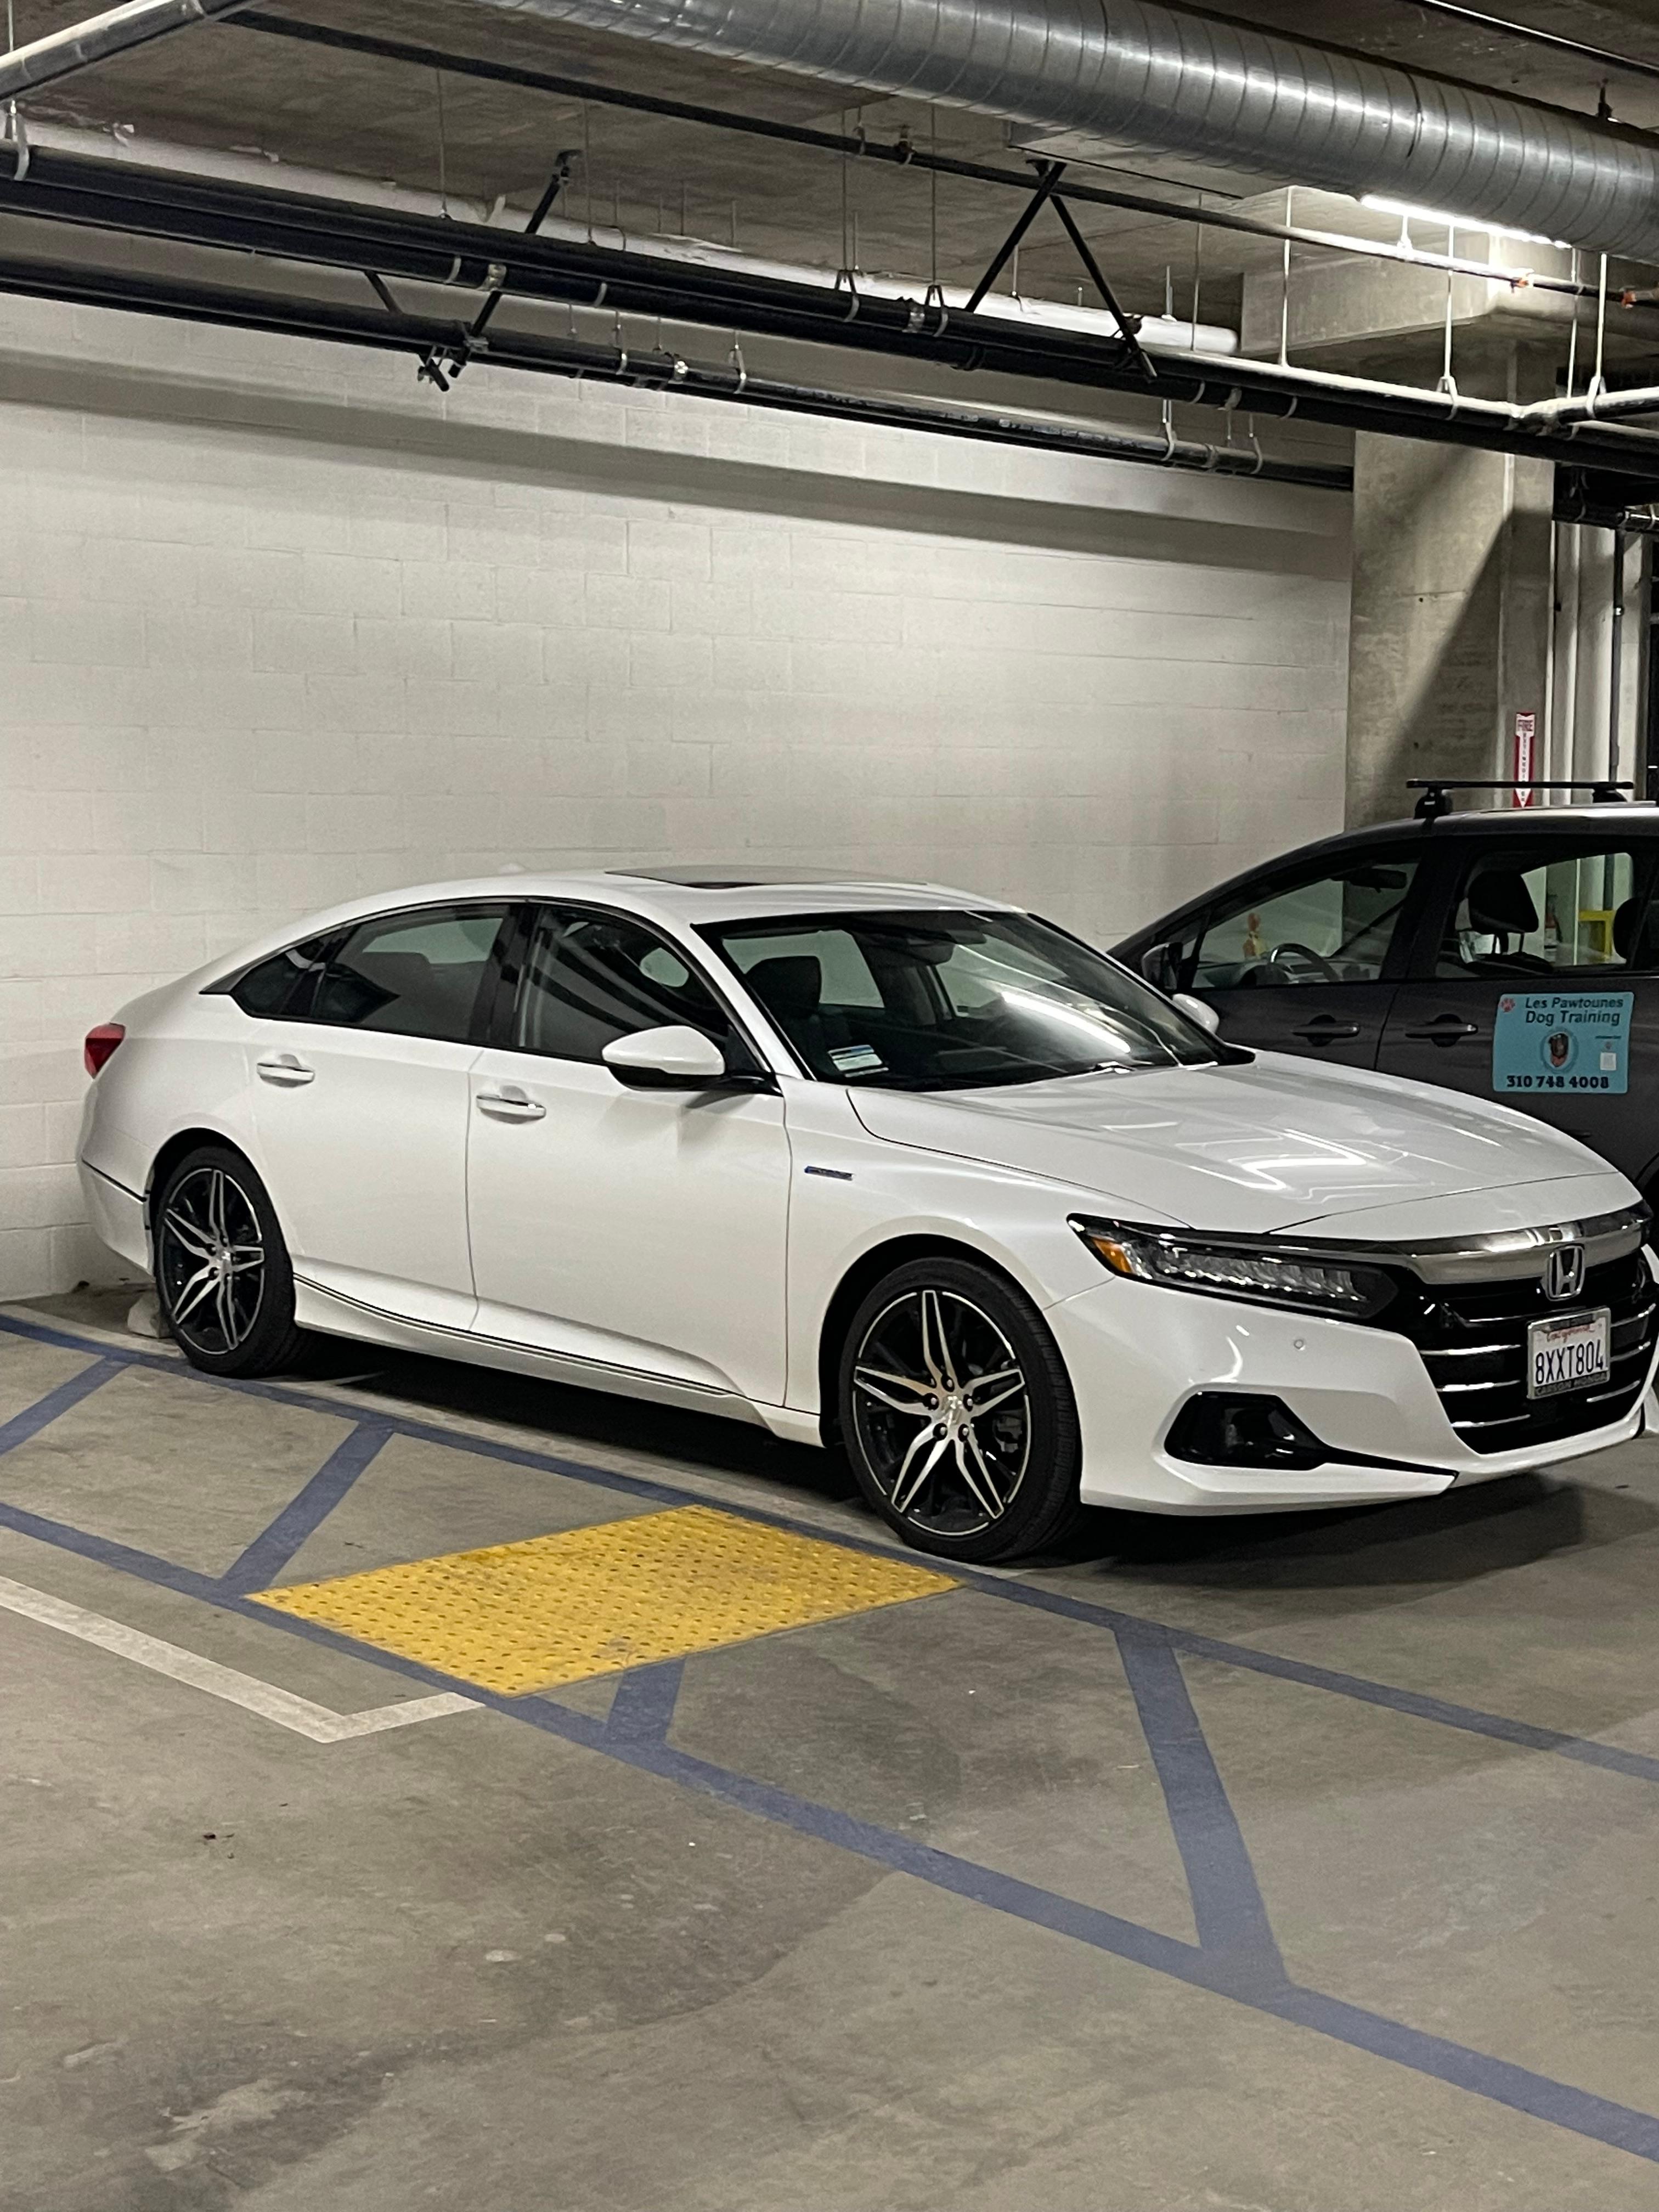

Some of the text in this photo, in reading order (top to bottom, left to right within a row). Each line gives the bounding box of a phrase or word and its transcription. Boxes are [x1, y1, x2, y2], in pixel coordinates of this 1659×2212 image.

[1525, 997, 1624, 1008] Les Pawtounes
[1525, 1010, 1621, 1026] Dog Training
[1506, 1075, 1609, 1088] 310 748 4008
[1536, 1339, 1604, 1384] 8XXT804
